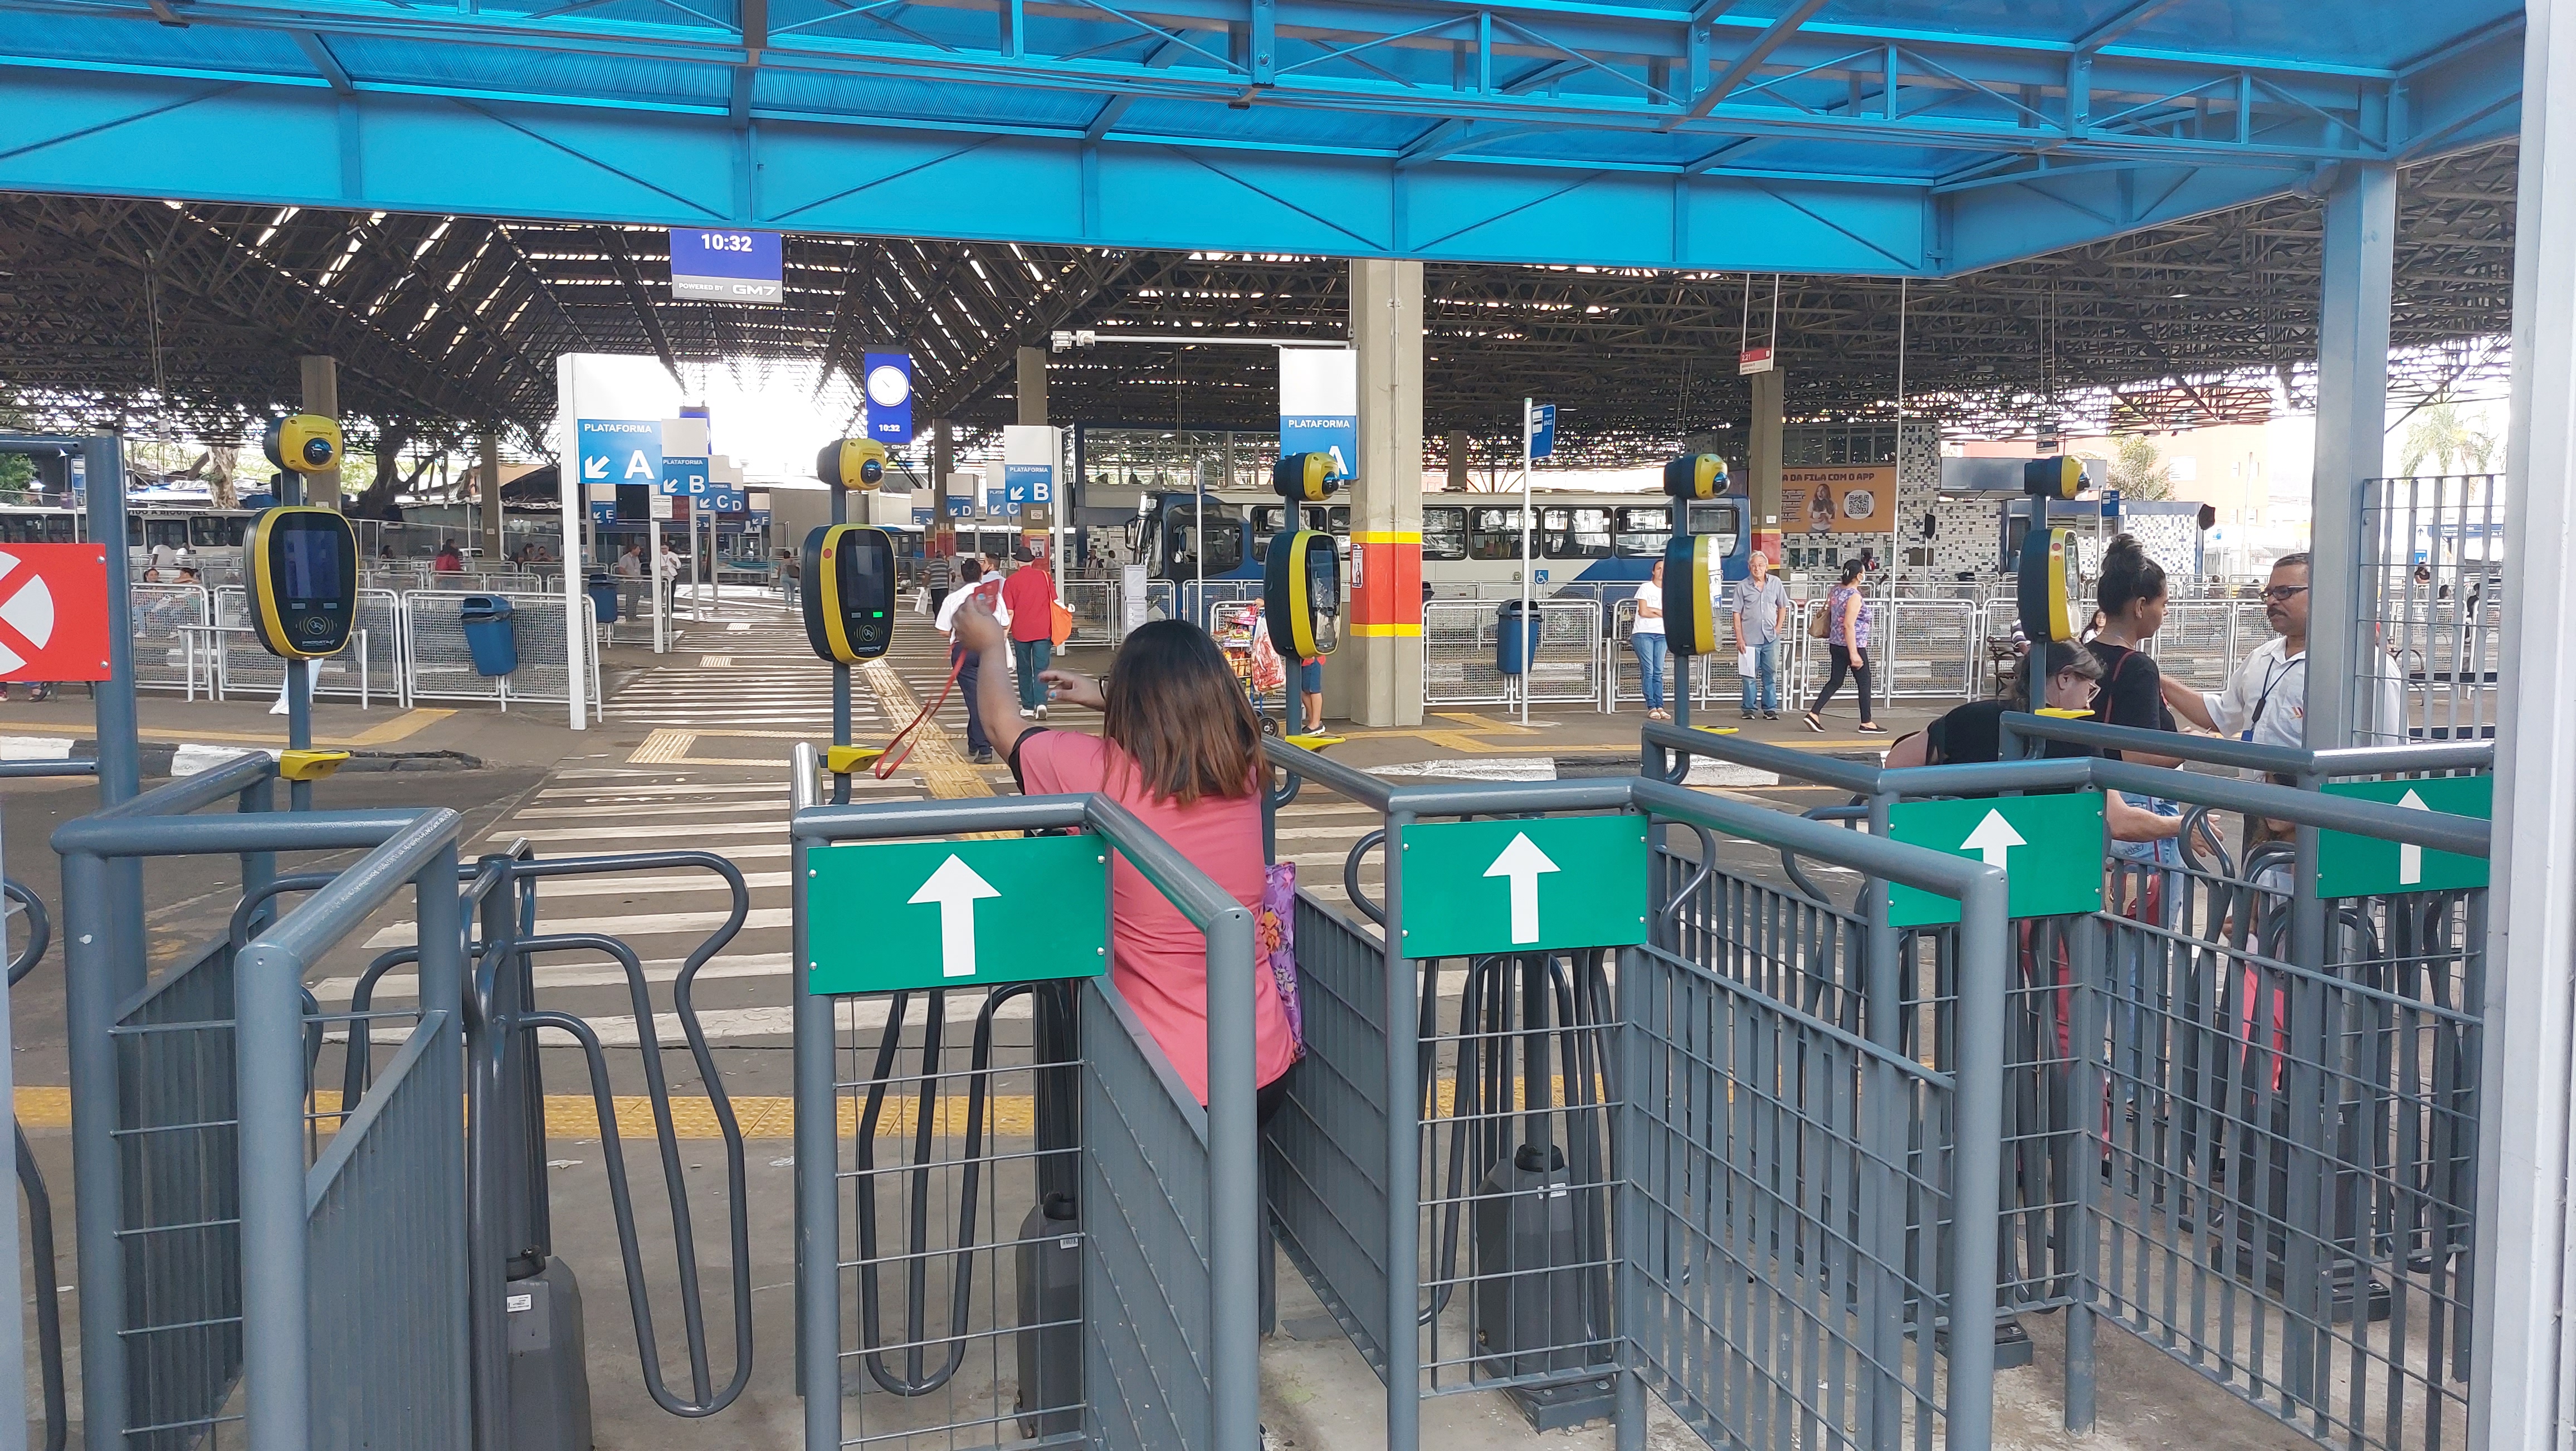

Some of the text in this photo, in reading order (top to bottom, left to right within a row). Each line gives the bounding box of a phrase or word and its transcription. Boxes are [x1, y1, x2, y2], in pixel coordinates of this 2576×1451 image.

[701, 233, 752, 252] 10:32
[732, 284, 777, 296] GM7
[584, 423, 652, 434] PLATAFORMA
[1288, 419, 1350, 429] PLATAFORMA
[624, 450, 655, 479] A
[1329, 445, 1349, 475] A
[689, 475, 705, 493] B
[1033, 483, 1049, 501] B
[716, 495, 729, 508] C
[732, 500, 742, 511] D
[606, 509, 614, 519] E
[962, 505, 972, 516] D
[1007, 502, 1018, 515] C
[762, 517, 769, 525] F
[913, 515, 921, 525] E
